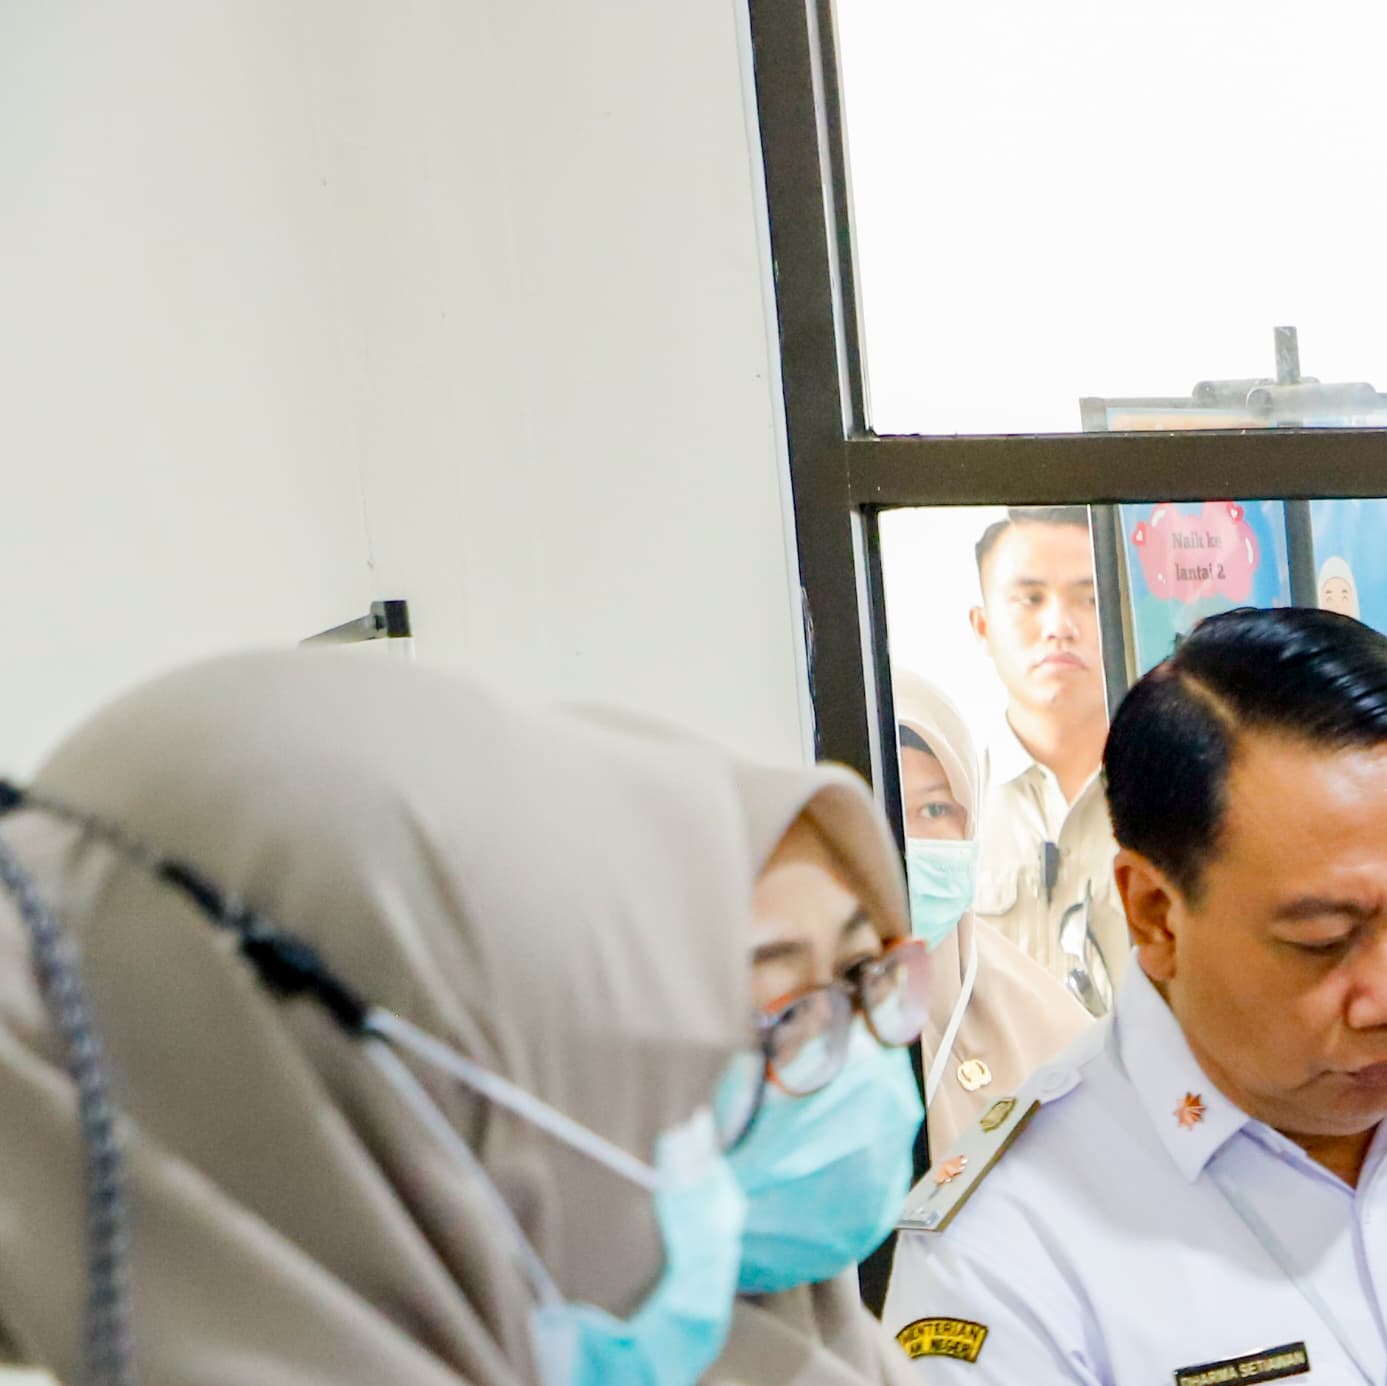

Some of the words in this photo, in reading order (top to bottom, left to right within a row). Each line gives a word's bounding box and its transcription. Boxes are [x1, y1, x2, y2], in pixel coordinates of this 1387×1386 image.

[1171, 531, 1204, 549] Naik
[1206, 531, 1222, 549] ke
[1175, 562, 1212, 581] lantai
[1217, 563, 1226, 580] 2
